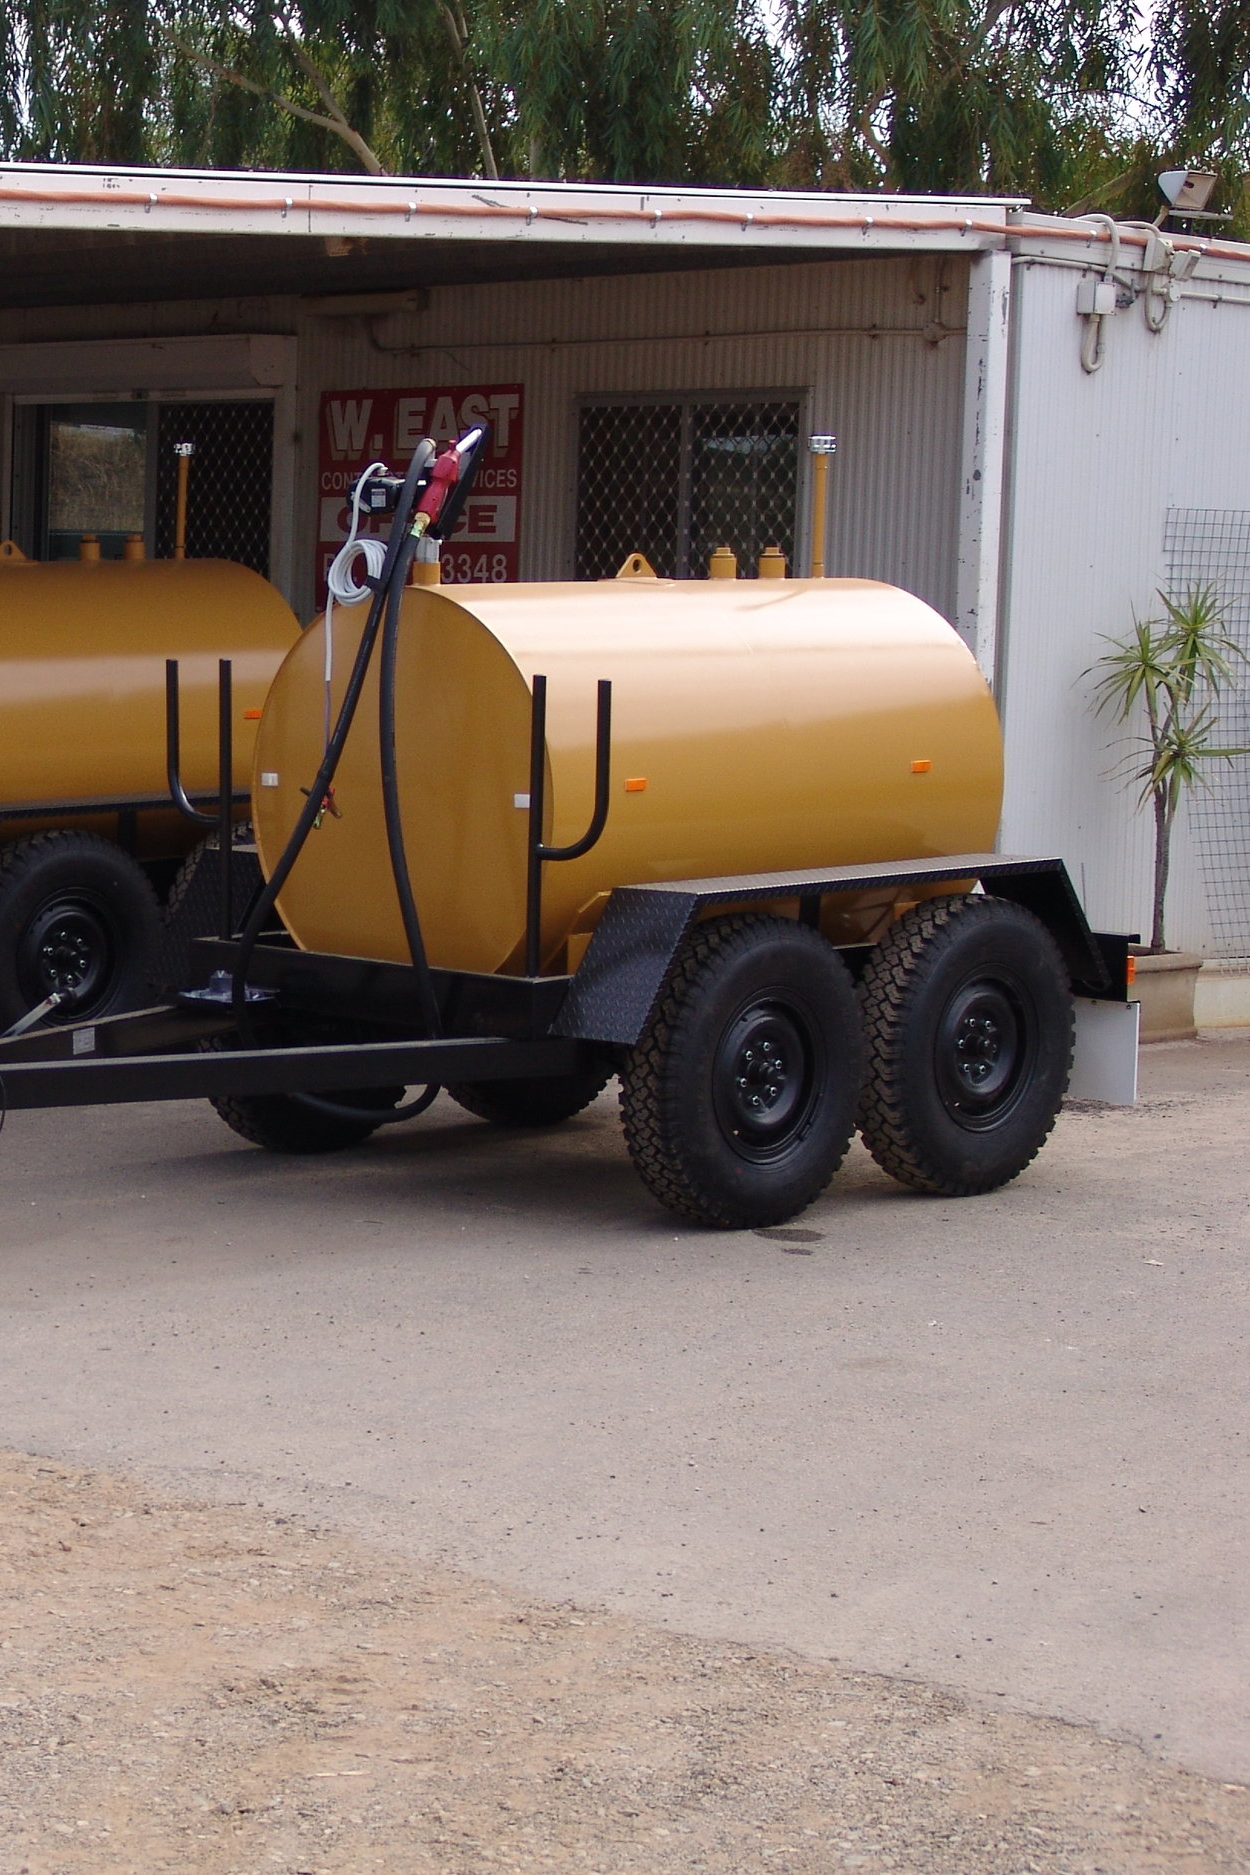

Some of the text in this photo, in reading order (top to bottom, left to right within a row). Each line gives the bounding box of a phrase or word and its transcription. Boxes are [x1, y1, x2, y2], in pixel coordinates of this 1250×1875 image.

[327, 393, 520, 456] W. EAST
[441, 553, 508, 583] 3348
